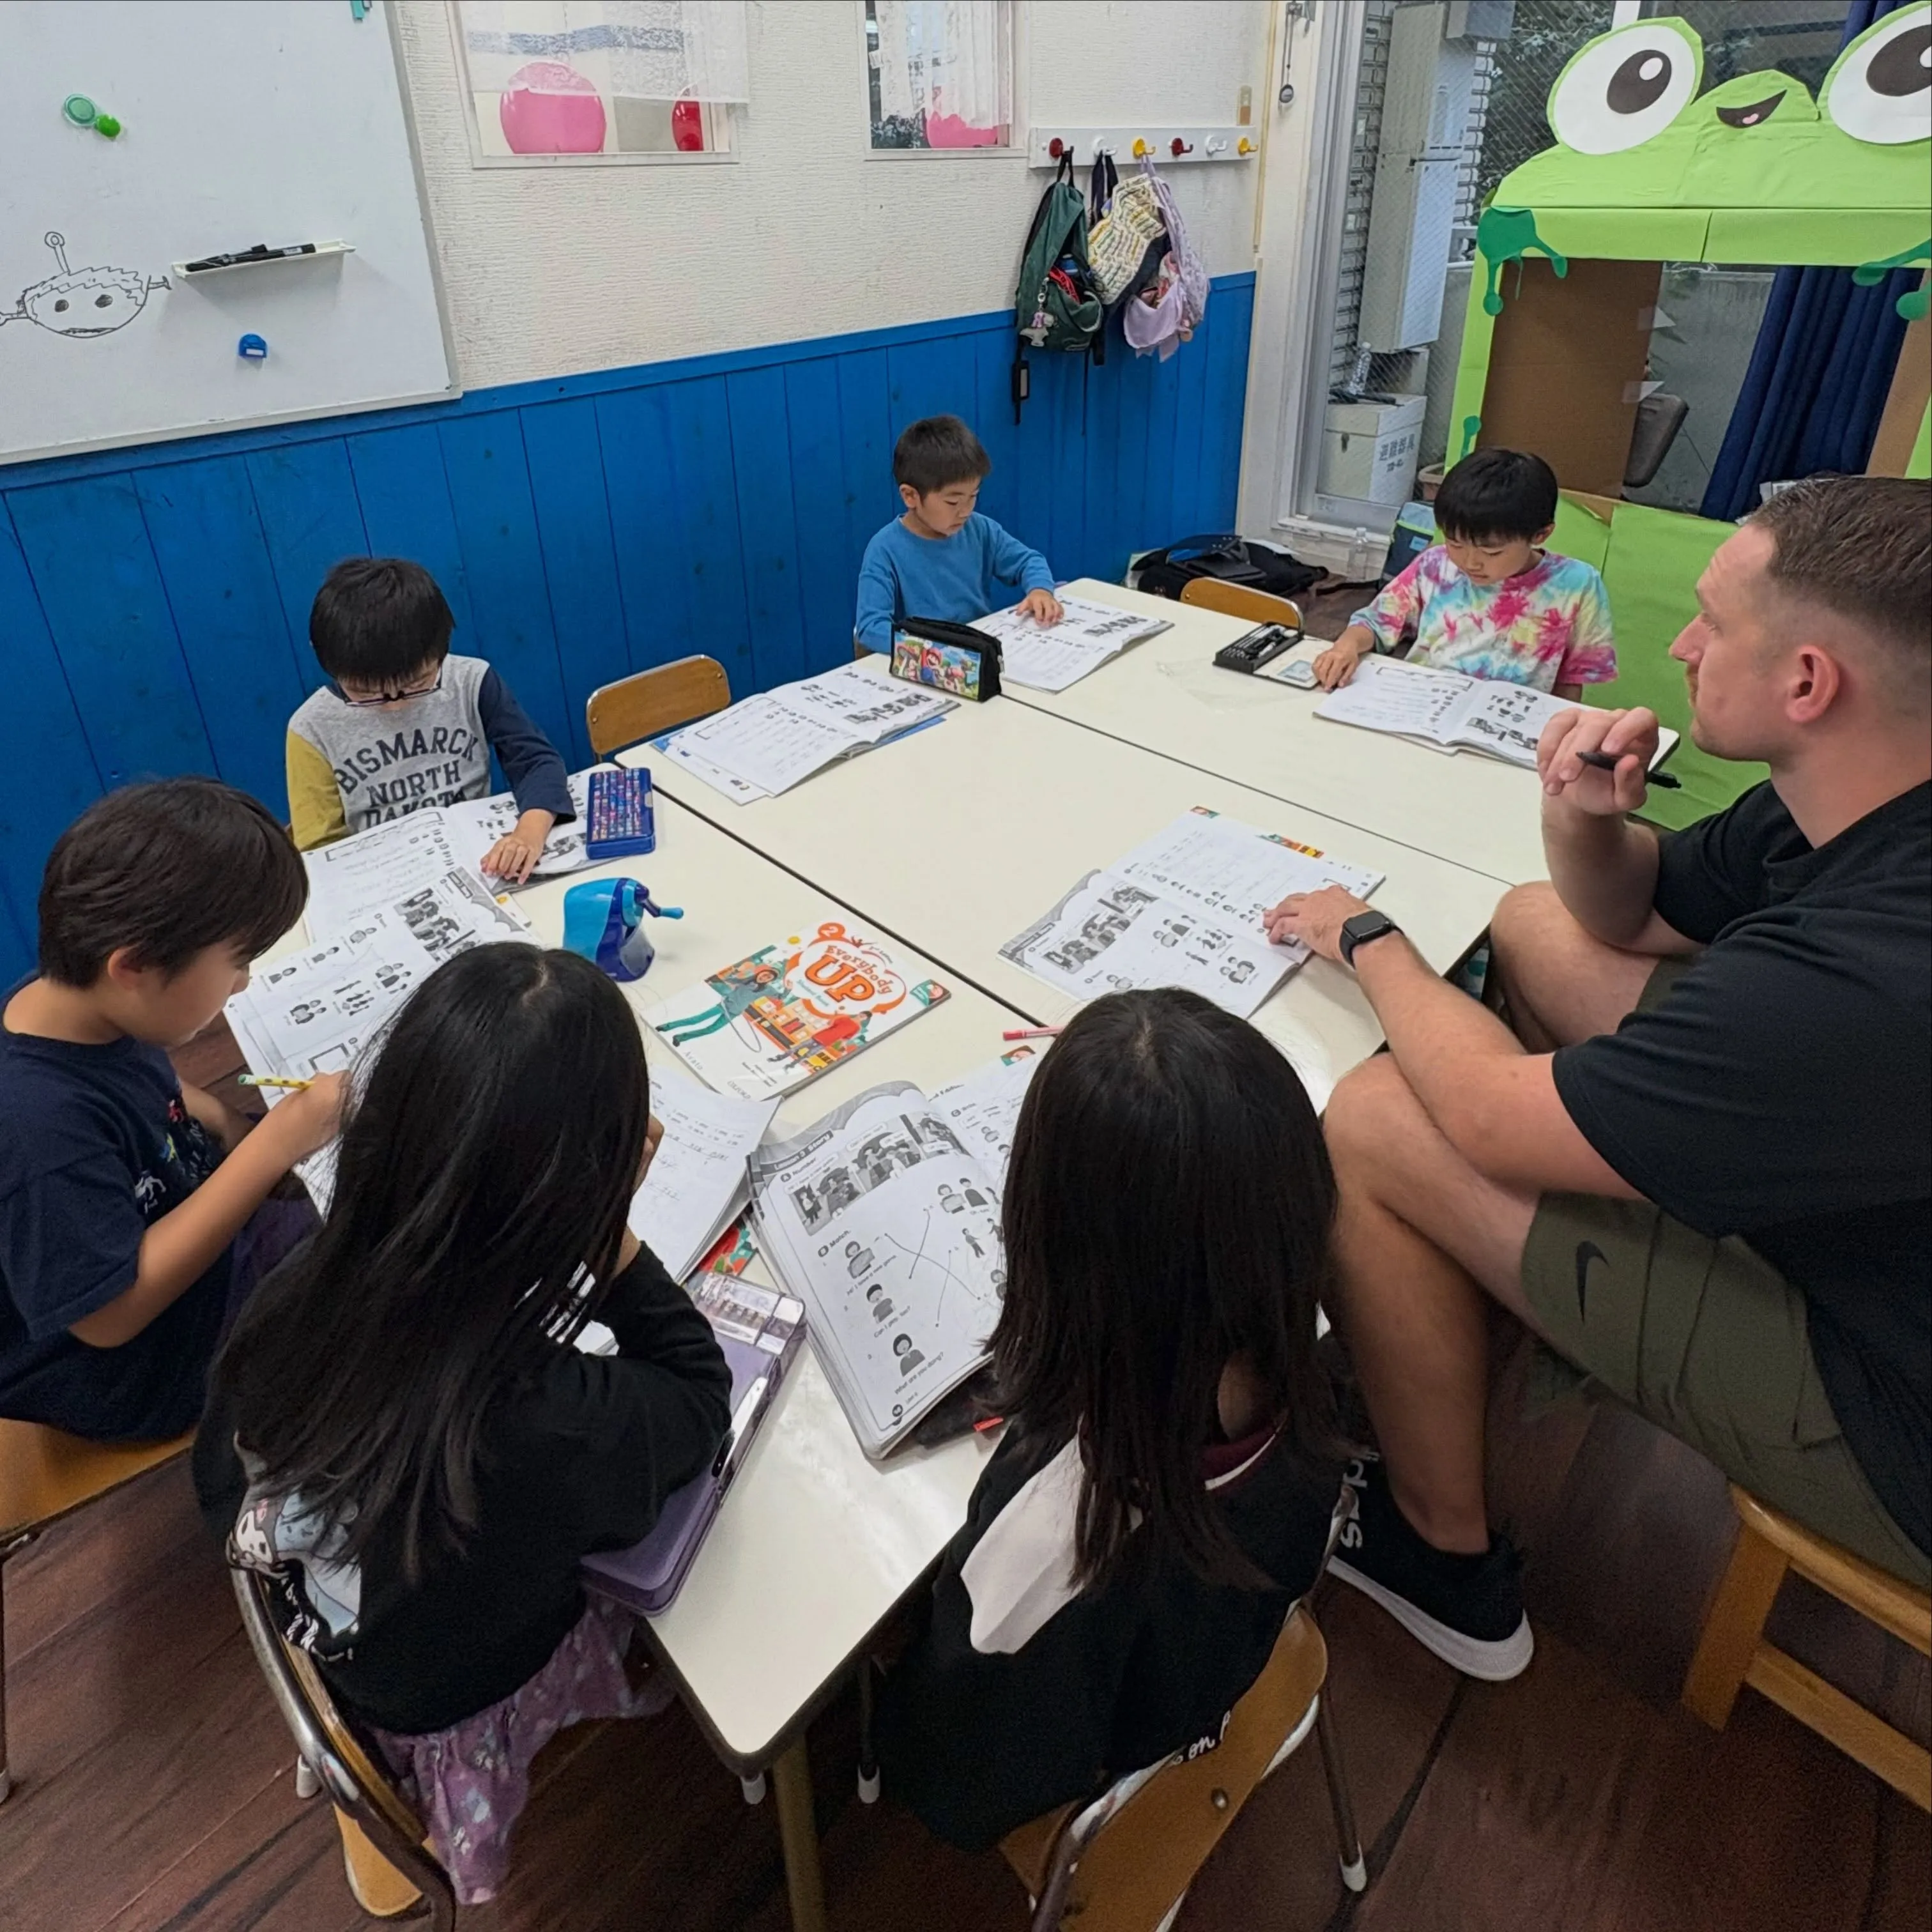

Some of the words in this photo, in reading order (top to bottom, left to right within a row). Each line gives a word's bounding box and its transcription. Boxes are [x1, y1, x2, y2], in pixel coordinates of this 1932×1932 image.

[334, 726, 479, 795] BISMARCK
[366, 760, 461, 808] NORTH
[821, 924, 838, 937] 2
[804, 953, 875, 1004] UP
[826, 945, 893, 993] Everybody
[774, 1155, 799, 1170] Lesson
[808, 1133, 830, 1151] Story
